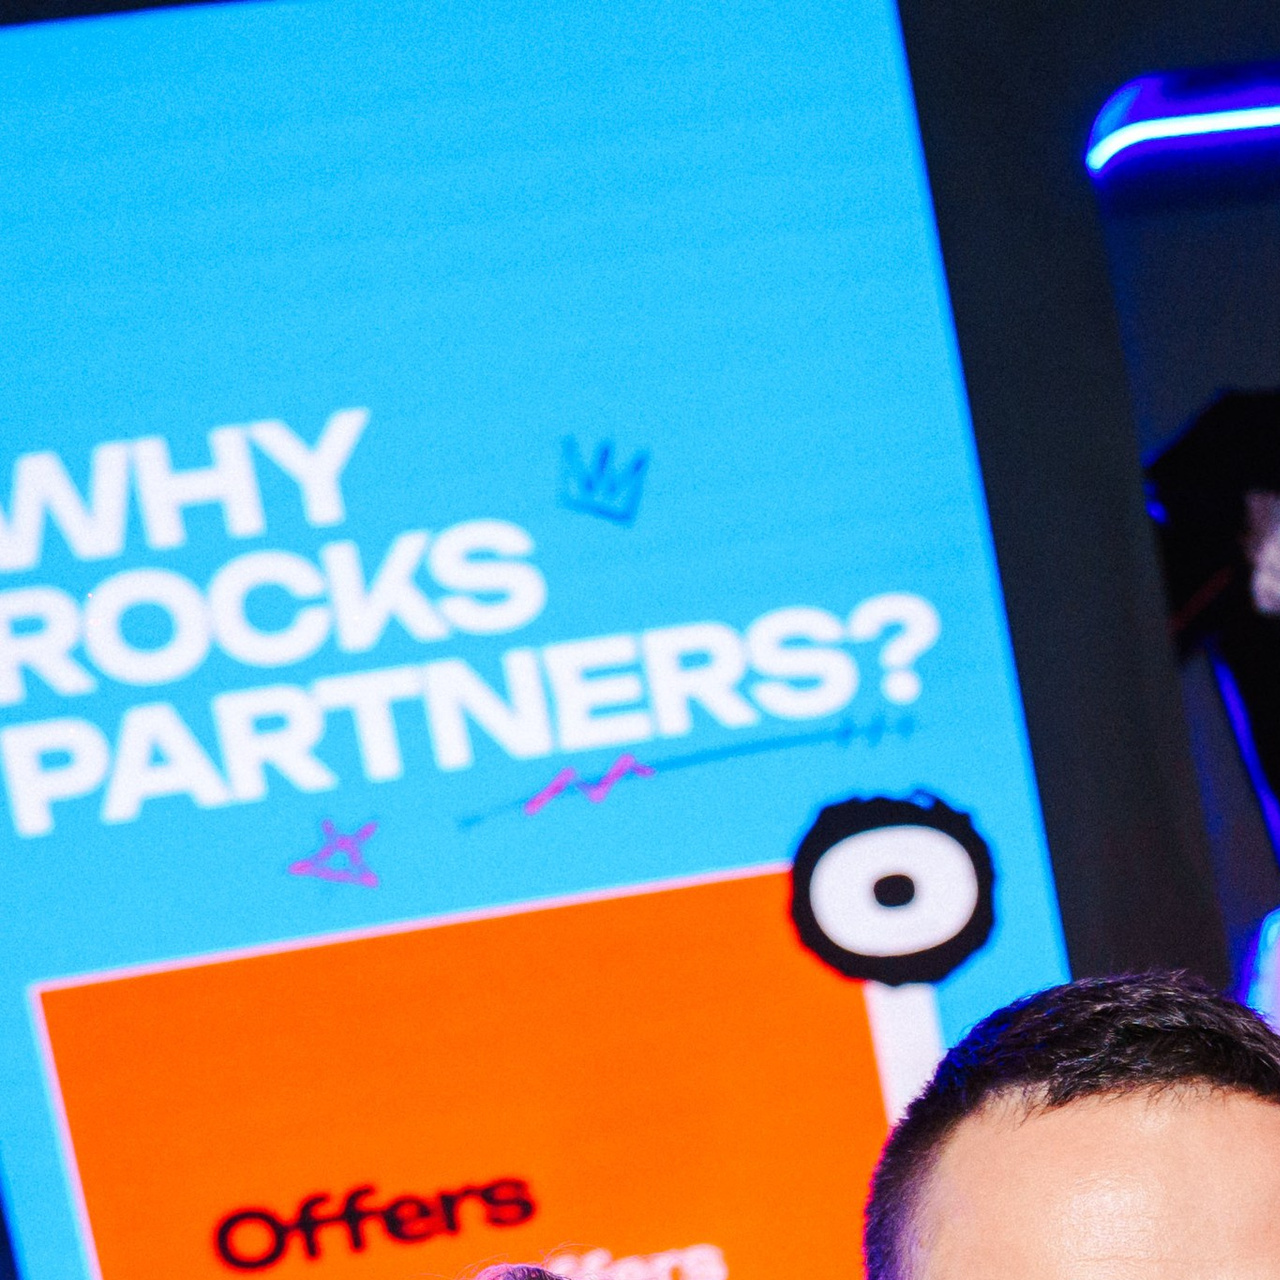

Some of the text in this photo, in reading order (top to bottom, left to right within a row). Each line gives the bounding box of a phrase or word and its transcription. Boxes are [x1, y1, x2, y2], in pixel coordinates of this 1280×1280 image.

[0, 407, 371, 571] WHY
[0, 517, 547, 706] ROCKS
[0, 592, 941, 838] PARTNERS?
[216, 1177, 535, 1270] Offers
